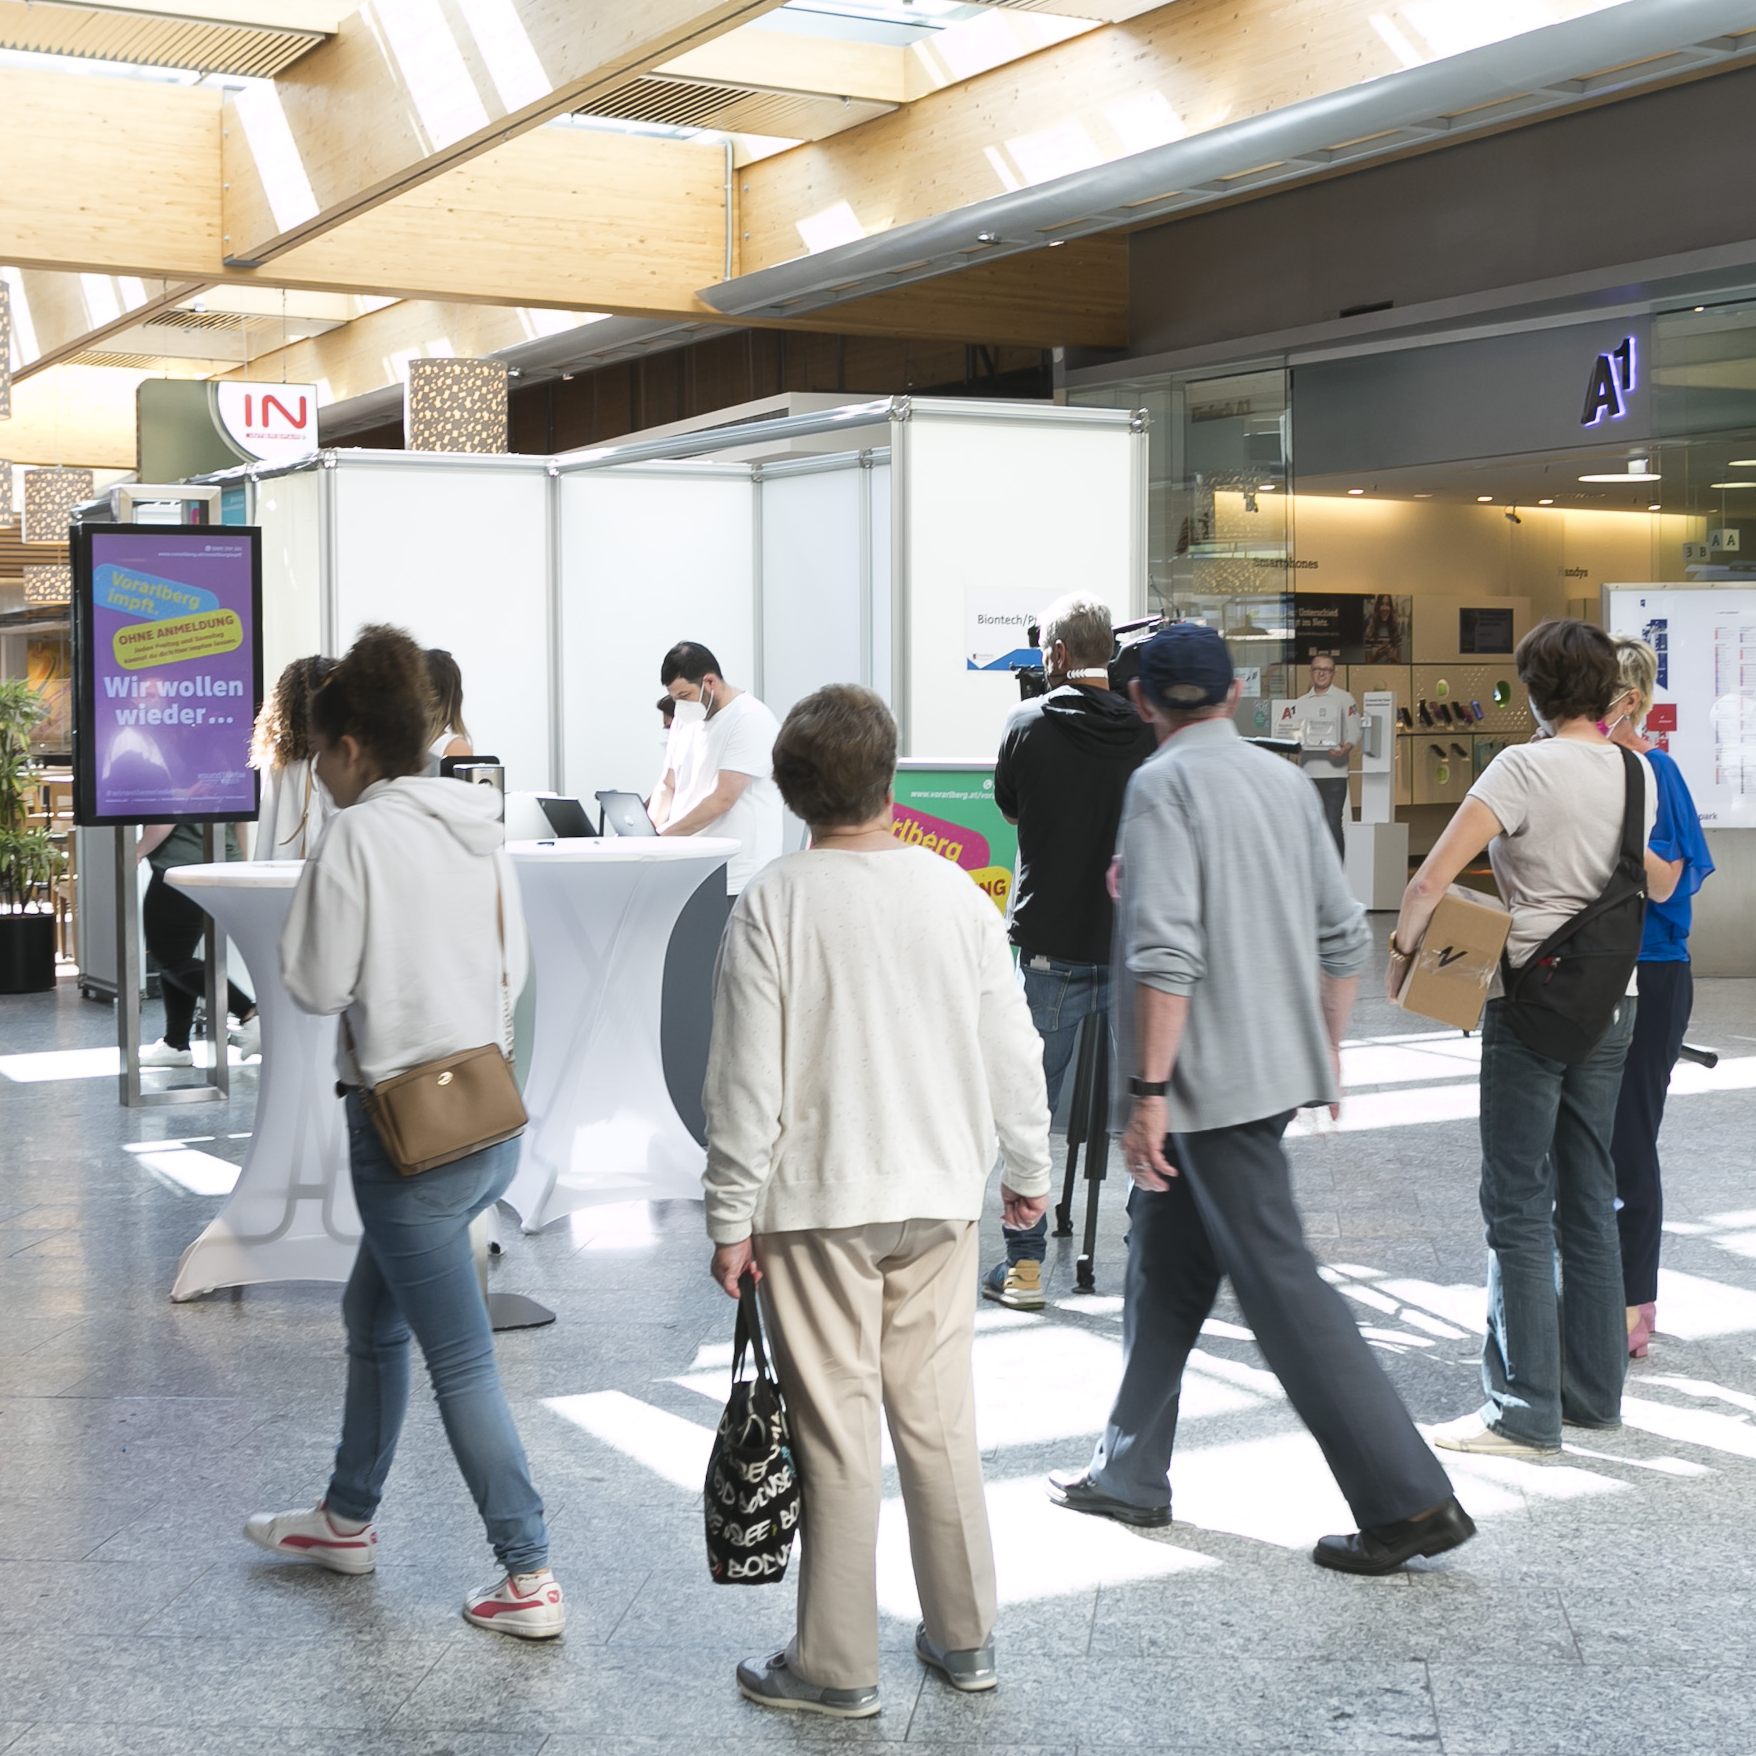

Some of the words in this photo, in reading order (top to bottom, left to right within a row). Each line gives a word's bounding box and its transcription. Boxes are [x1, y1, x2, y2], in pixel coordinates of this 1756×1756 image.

[1581, 337, 1636, 427] A1
[245, 393, 307, 429] IN
[1712, 534, 1720, 546] A
[1727, 534, 1736, 546] A
[107, 588, 160, 616] impft.
[111, 571, 201, 610] Vorarlberg
[118, 629, 154, 646] OHNE
[156, 615, 234, 638] ANMELDUNG
[104, 676, 150, 698] Wir
[157, 676, 243, 697] wollen
[1698, 812, 1718, 824] park
[891, 818, 964, 863] rlberg
